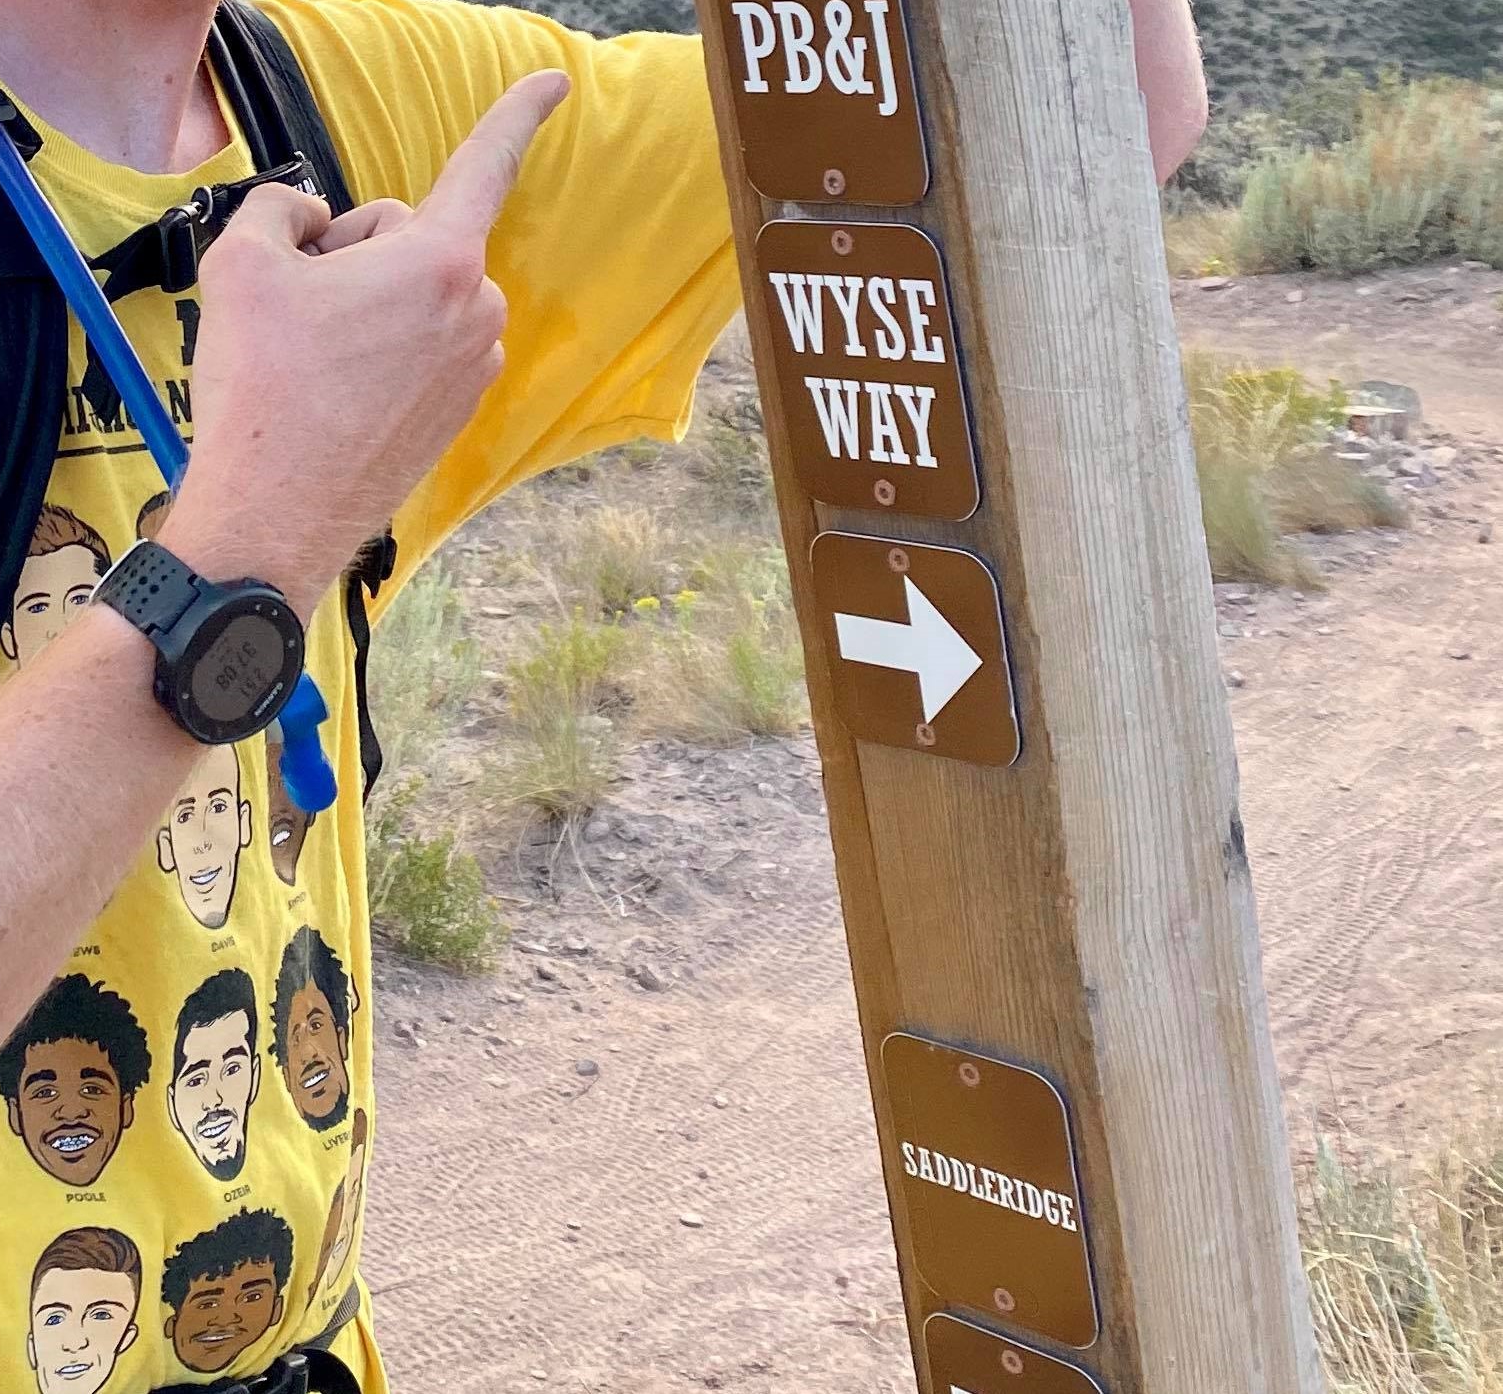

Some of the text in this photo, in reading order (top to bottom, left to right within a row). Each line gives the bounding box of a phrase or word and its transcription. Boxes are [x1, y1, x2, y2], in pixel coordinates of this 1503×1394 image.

[768, 272, 946, 364] WYSE
[803, 376, 939, 469] WAY
[322, 1131, 350, 1151] LIVER
[901, 1140, 1078, 1233] SADDLERIDGE
[66, 1192, 107, 1204] POOLE
